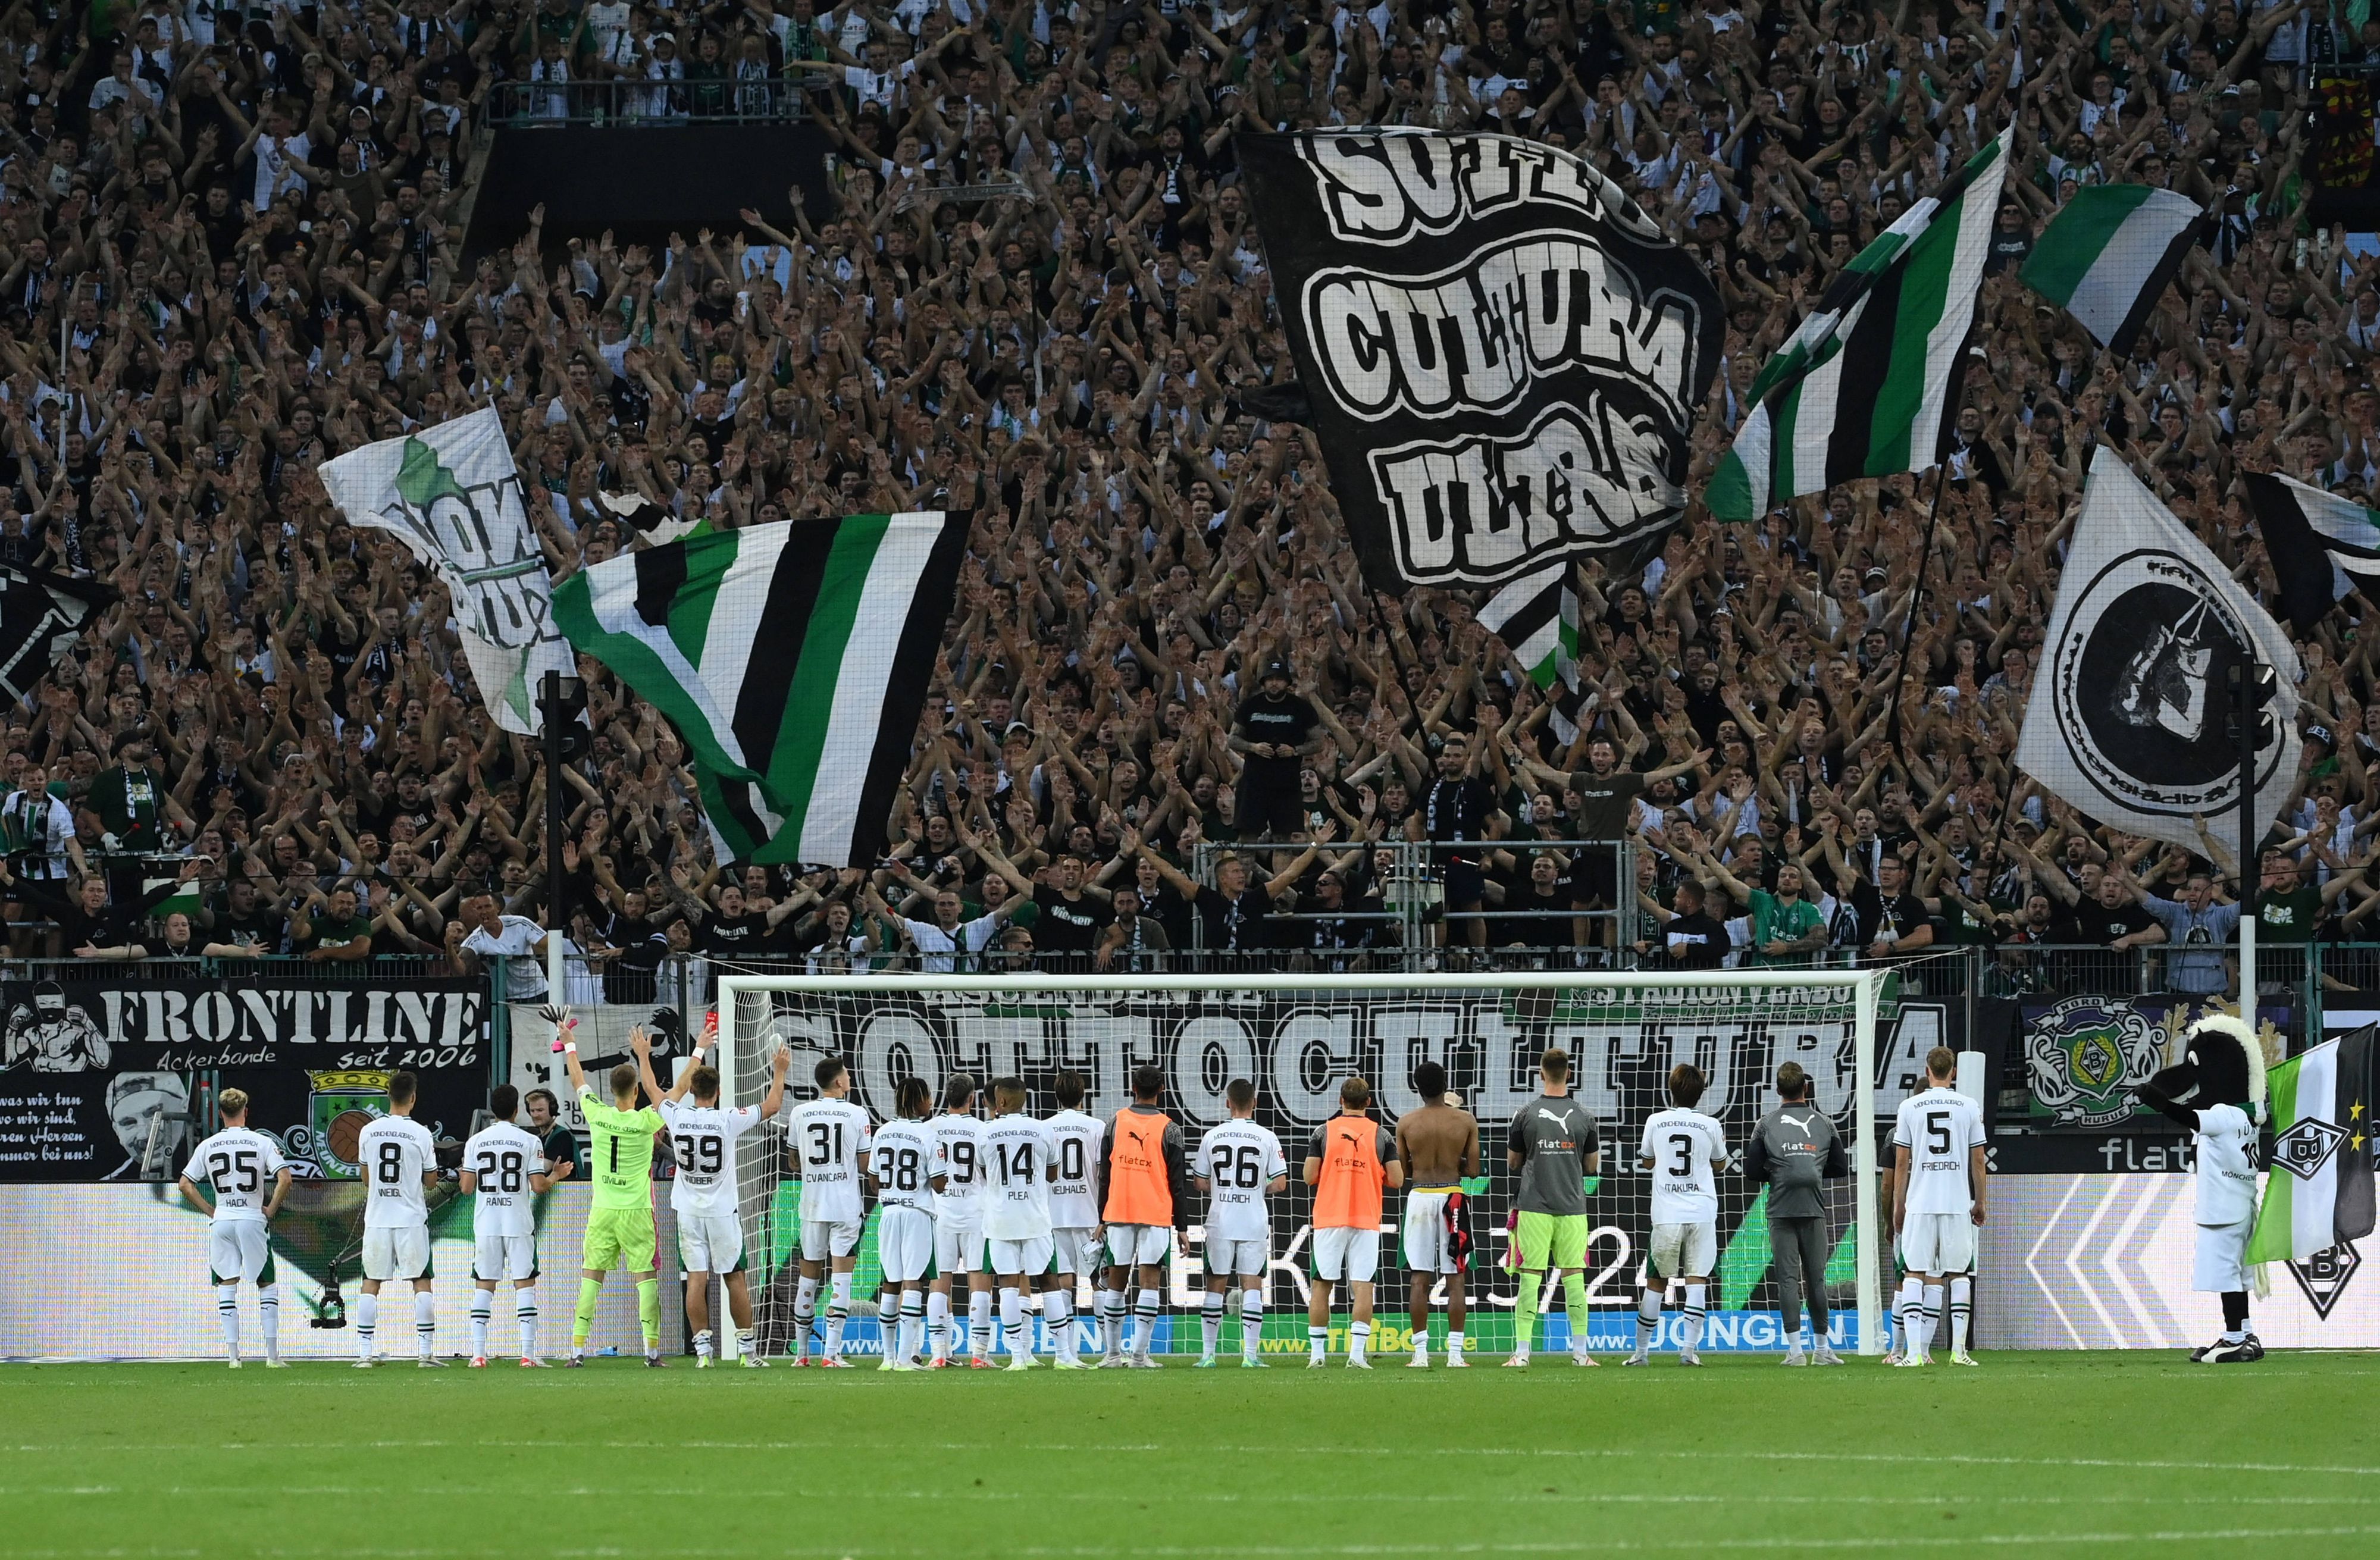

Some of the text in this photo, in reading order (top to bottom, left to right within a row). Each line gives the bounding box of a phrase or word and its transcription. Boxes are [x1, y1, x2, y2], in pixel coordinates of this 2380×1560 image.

[1320, 241, 1685, 416] CULTURA
[2061, 998, 2100, 1011] NORD
[99, 989, 480, 1046] FRONTLINE
[157, 1044, 477, 1070] Ackerbande seit 2006
[27, 1092, 51, 1106] wir
[17, 1111, 41, 1124] wir
[45, 1107, 76, 1125] sind,
[30, 1126, 86, 1145] Herzen
[807, 1123, 843, 1166] 31
[1537, 1138, 1575, 1149] flatex
[1927, 1112, 1951, 1155] 5
[42, 1144, 61, 1161] bei
[64, 1144, 94, 1160] uns!
[610, 1135, 619, 1174] 1
[674, 1135, 722, 1173] 39
[1668, 1134, 1693, 1177] 3
[1781, 1142, 1817, 1152] flatex
[2097, 1138, 2193, 1171] flat
[2241, 1142, 2258, 1169] 10
[379, 1142, 402, 1185] 8
[878, 1147, 919, 1191] 38
[997, 1142, 1034, 1186] 14
[1119, 1154, 1152, 1167] flatex
[1212, 1145, 1261, 1189] 26
[1921, 1161, 1961, 1171] FRIEDRICH
[209, 1151, 258, 1194] 25
[477, 1151, 524, 1193] 28
[378, 1188, 402, 1197] WEIGL
[1008, 1191, 1029, 1200] PLEA
[1051, 1185, 1087, 1195] NEUHAUS
[1219, 1194, 1250, 1204] ULLRICH
[1665, 1183, 1700, 1193] ITAKURA
[226, 1198, 248, 1207] HACK
[486, 1197, 512, 1207] RANOS
